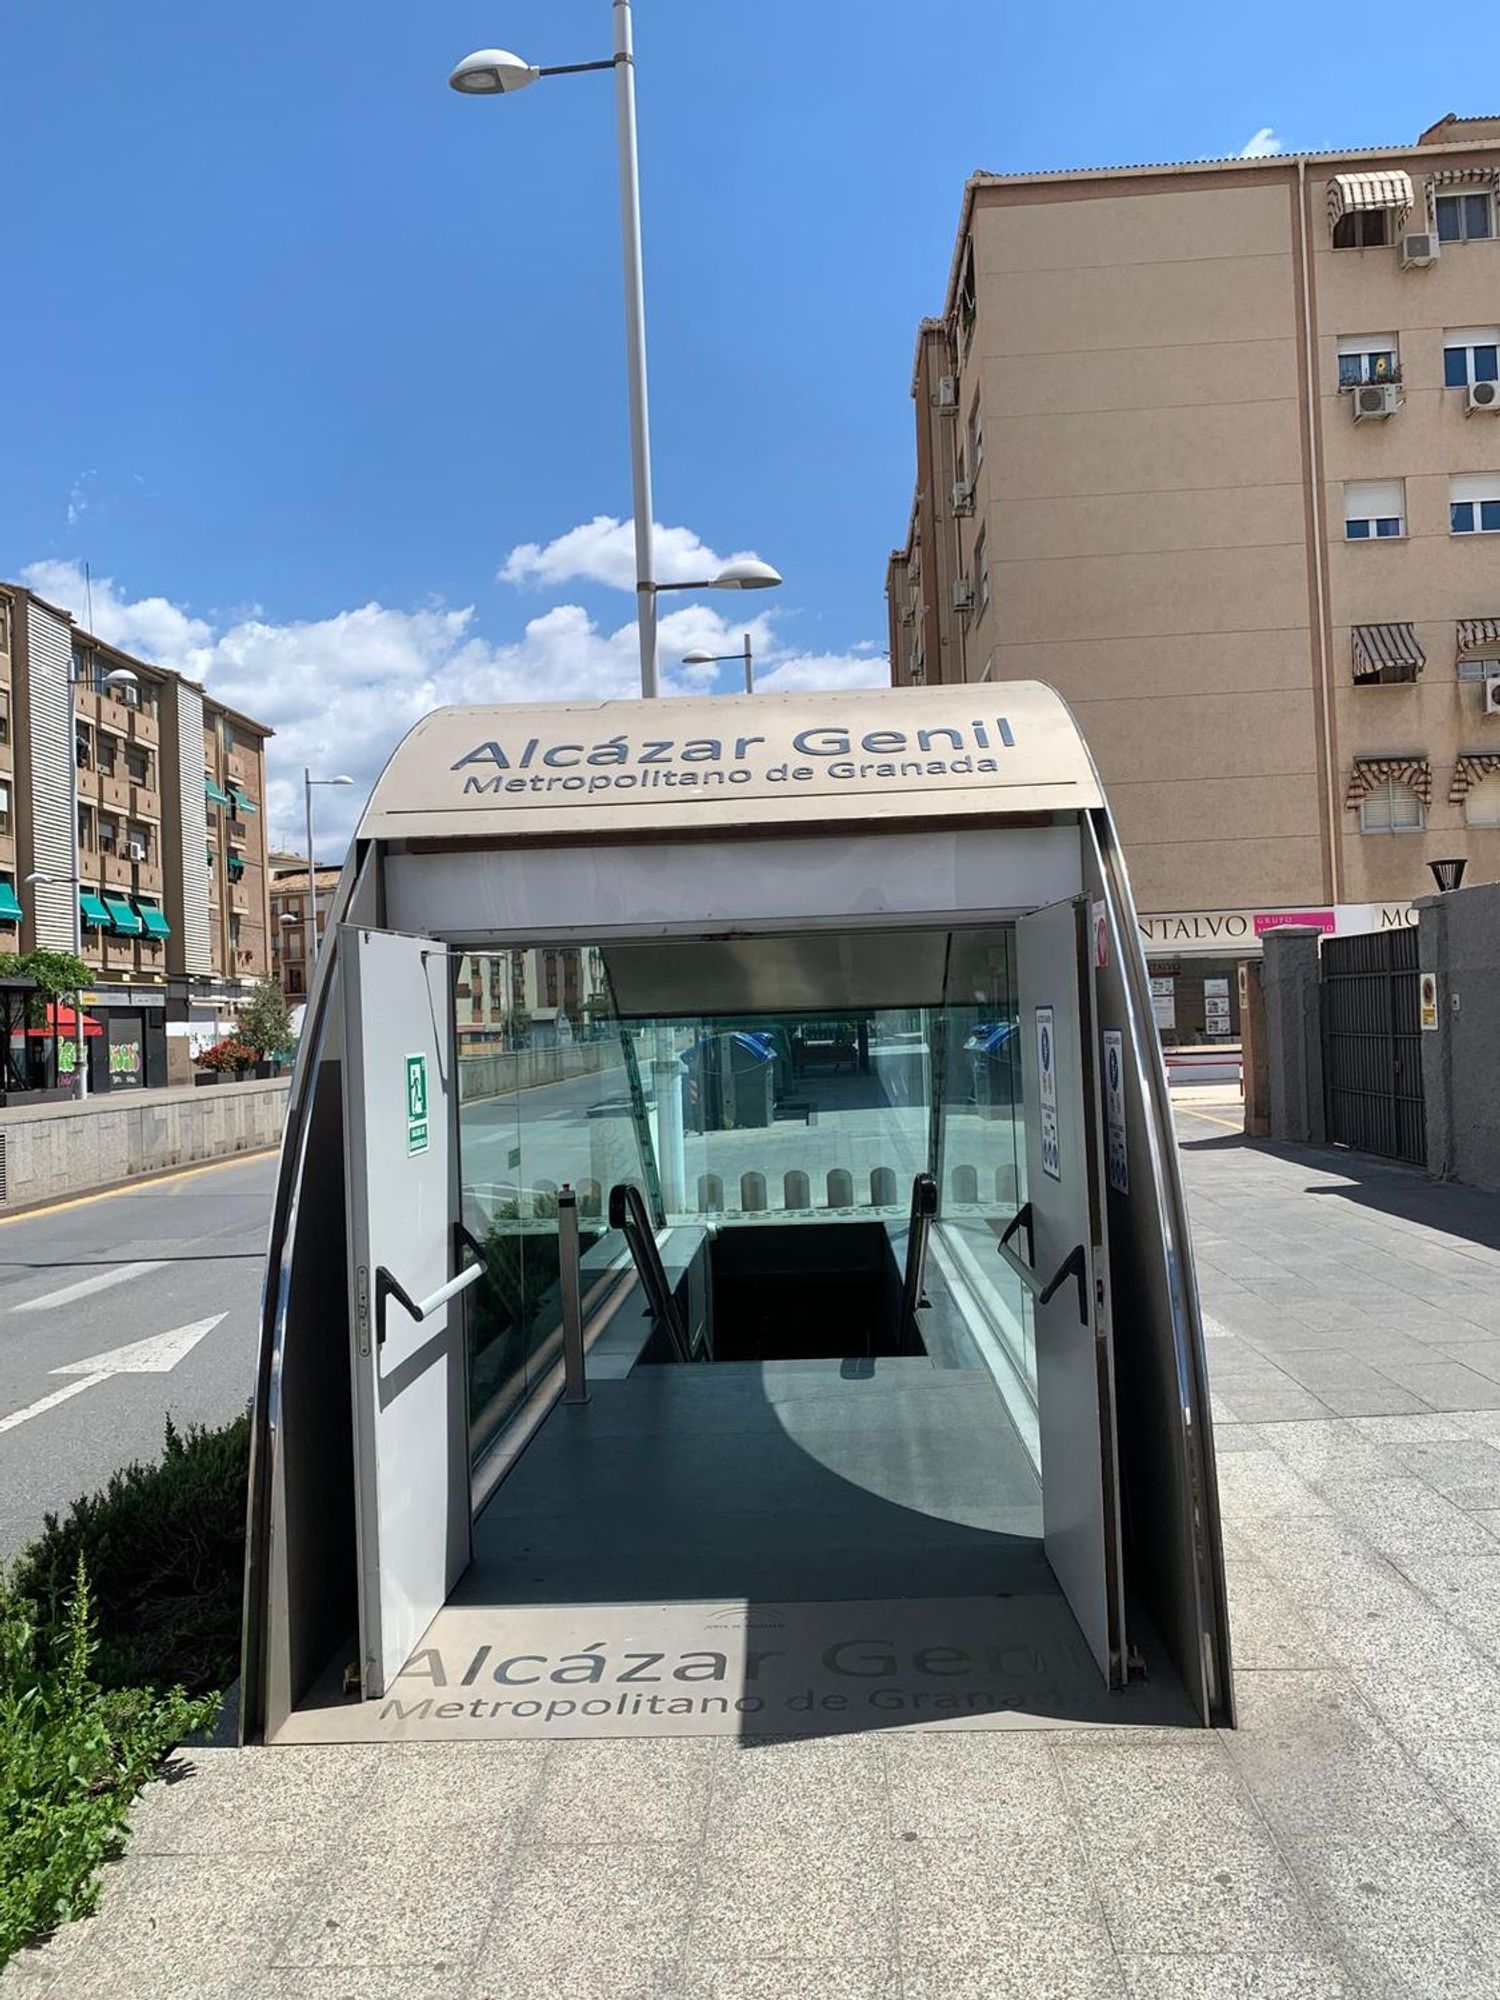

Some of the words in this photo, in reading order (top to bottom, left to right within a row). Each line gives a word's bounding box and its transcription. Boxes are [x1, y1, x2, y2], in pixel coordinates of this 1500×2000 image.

[450, 735, 766, 771] Alcázar
[792, 717, 1015, 757] Genil
[462, 769, 752, 794] Metropolitano
[766, 763, 814, 783] de
[827, 755, 999, 780] Granada
[398, 1641, 787, 1687] Alcázar
[378, 1692, 766, 1722] Metropolitano
[784, 1688, 849, 1712] de
[867, 1679, 1096, 1712] Granad
